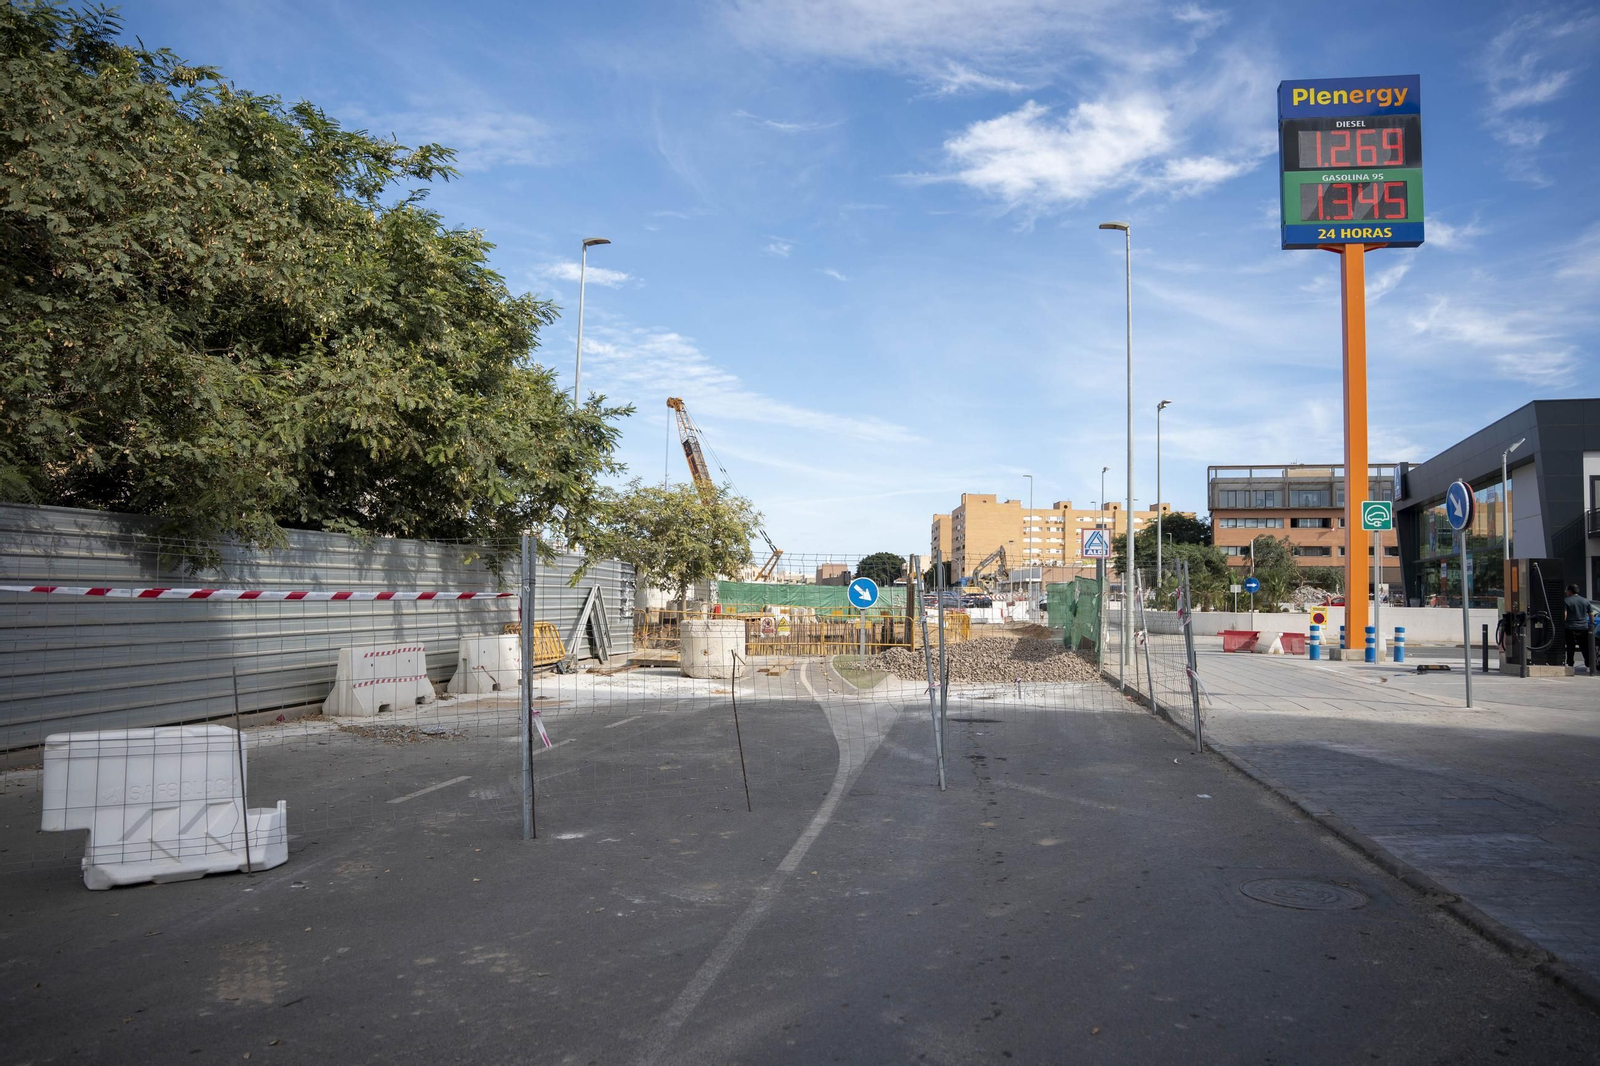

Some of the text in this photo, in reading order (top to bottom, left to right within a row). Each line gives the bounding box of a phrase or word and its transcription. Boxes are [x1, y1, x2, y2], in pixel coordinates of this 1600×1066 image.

[1292, 87, 1408, 107] Plenergy
[1336, 120, 1366, 128] DIESEL
[1316, 128, 1403, 167] 1.269
[1322, 173, 1384, 182] GASOLINA 95
[1317, 182, 1405, 220] 1.345
[1317, 227, 1392, 239] 24 HORAS
